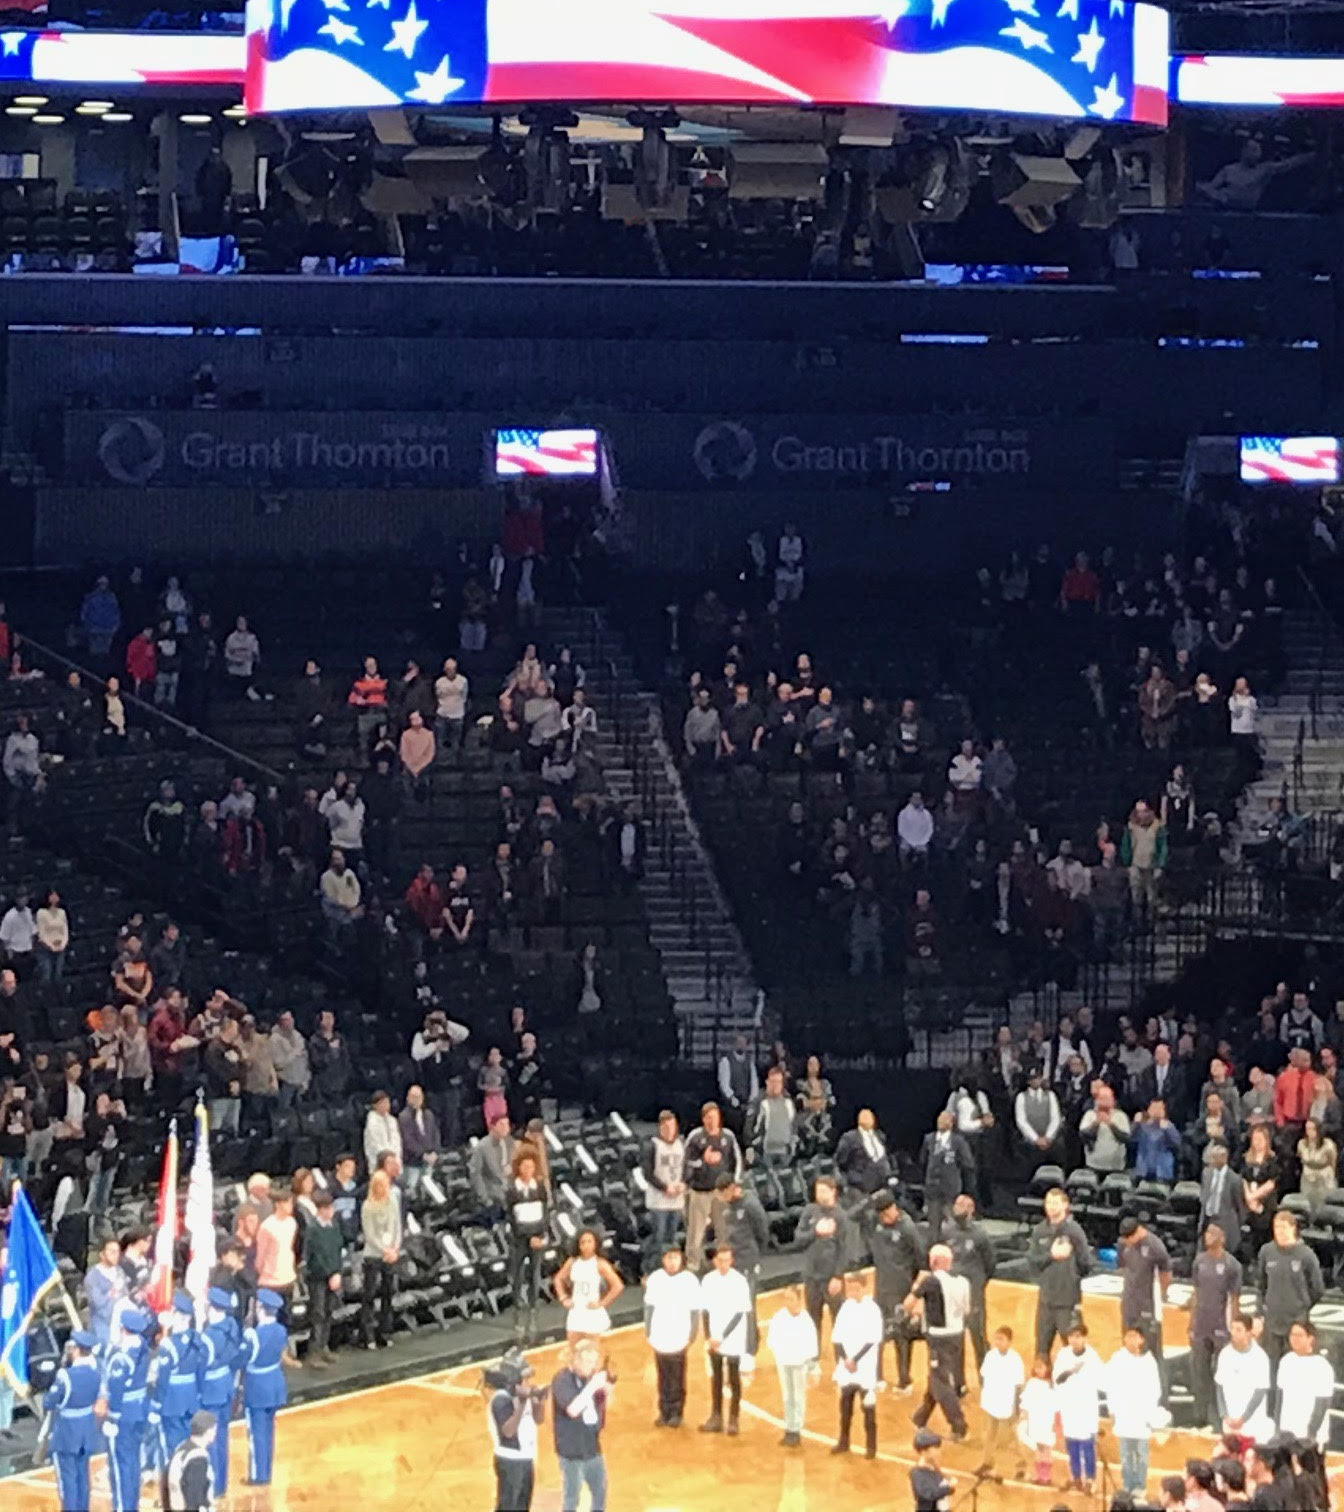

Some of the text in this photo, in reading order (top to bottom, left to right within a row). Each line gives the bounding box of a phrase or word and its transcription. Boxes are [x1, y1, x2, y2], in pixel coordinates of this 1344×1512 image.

[181, 432, 450, 469] Grant Thornton
[771, 435, 1031, 474] Grant Thornton
